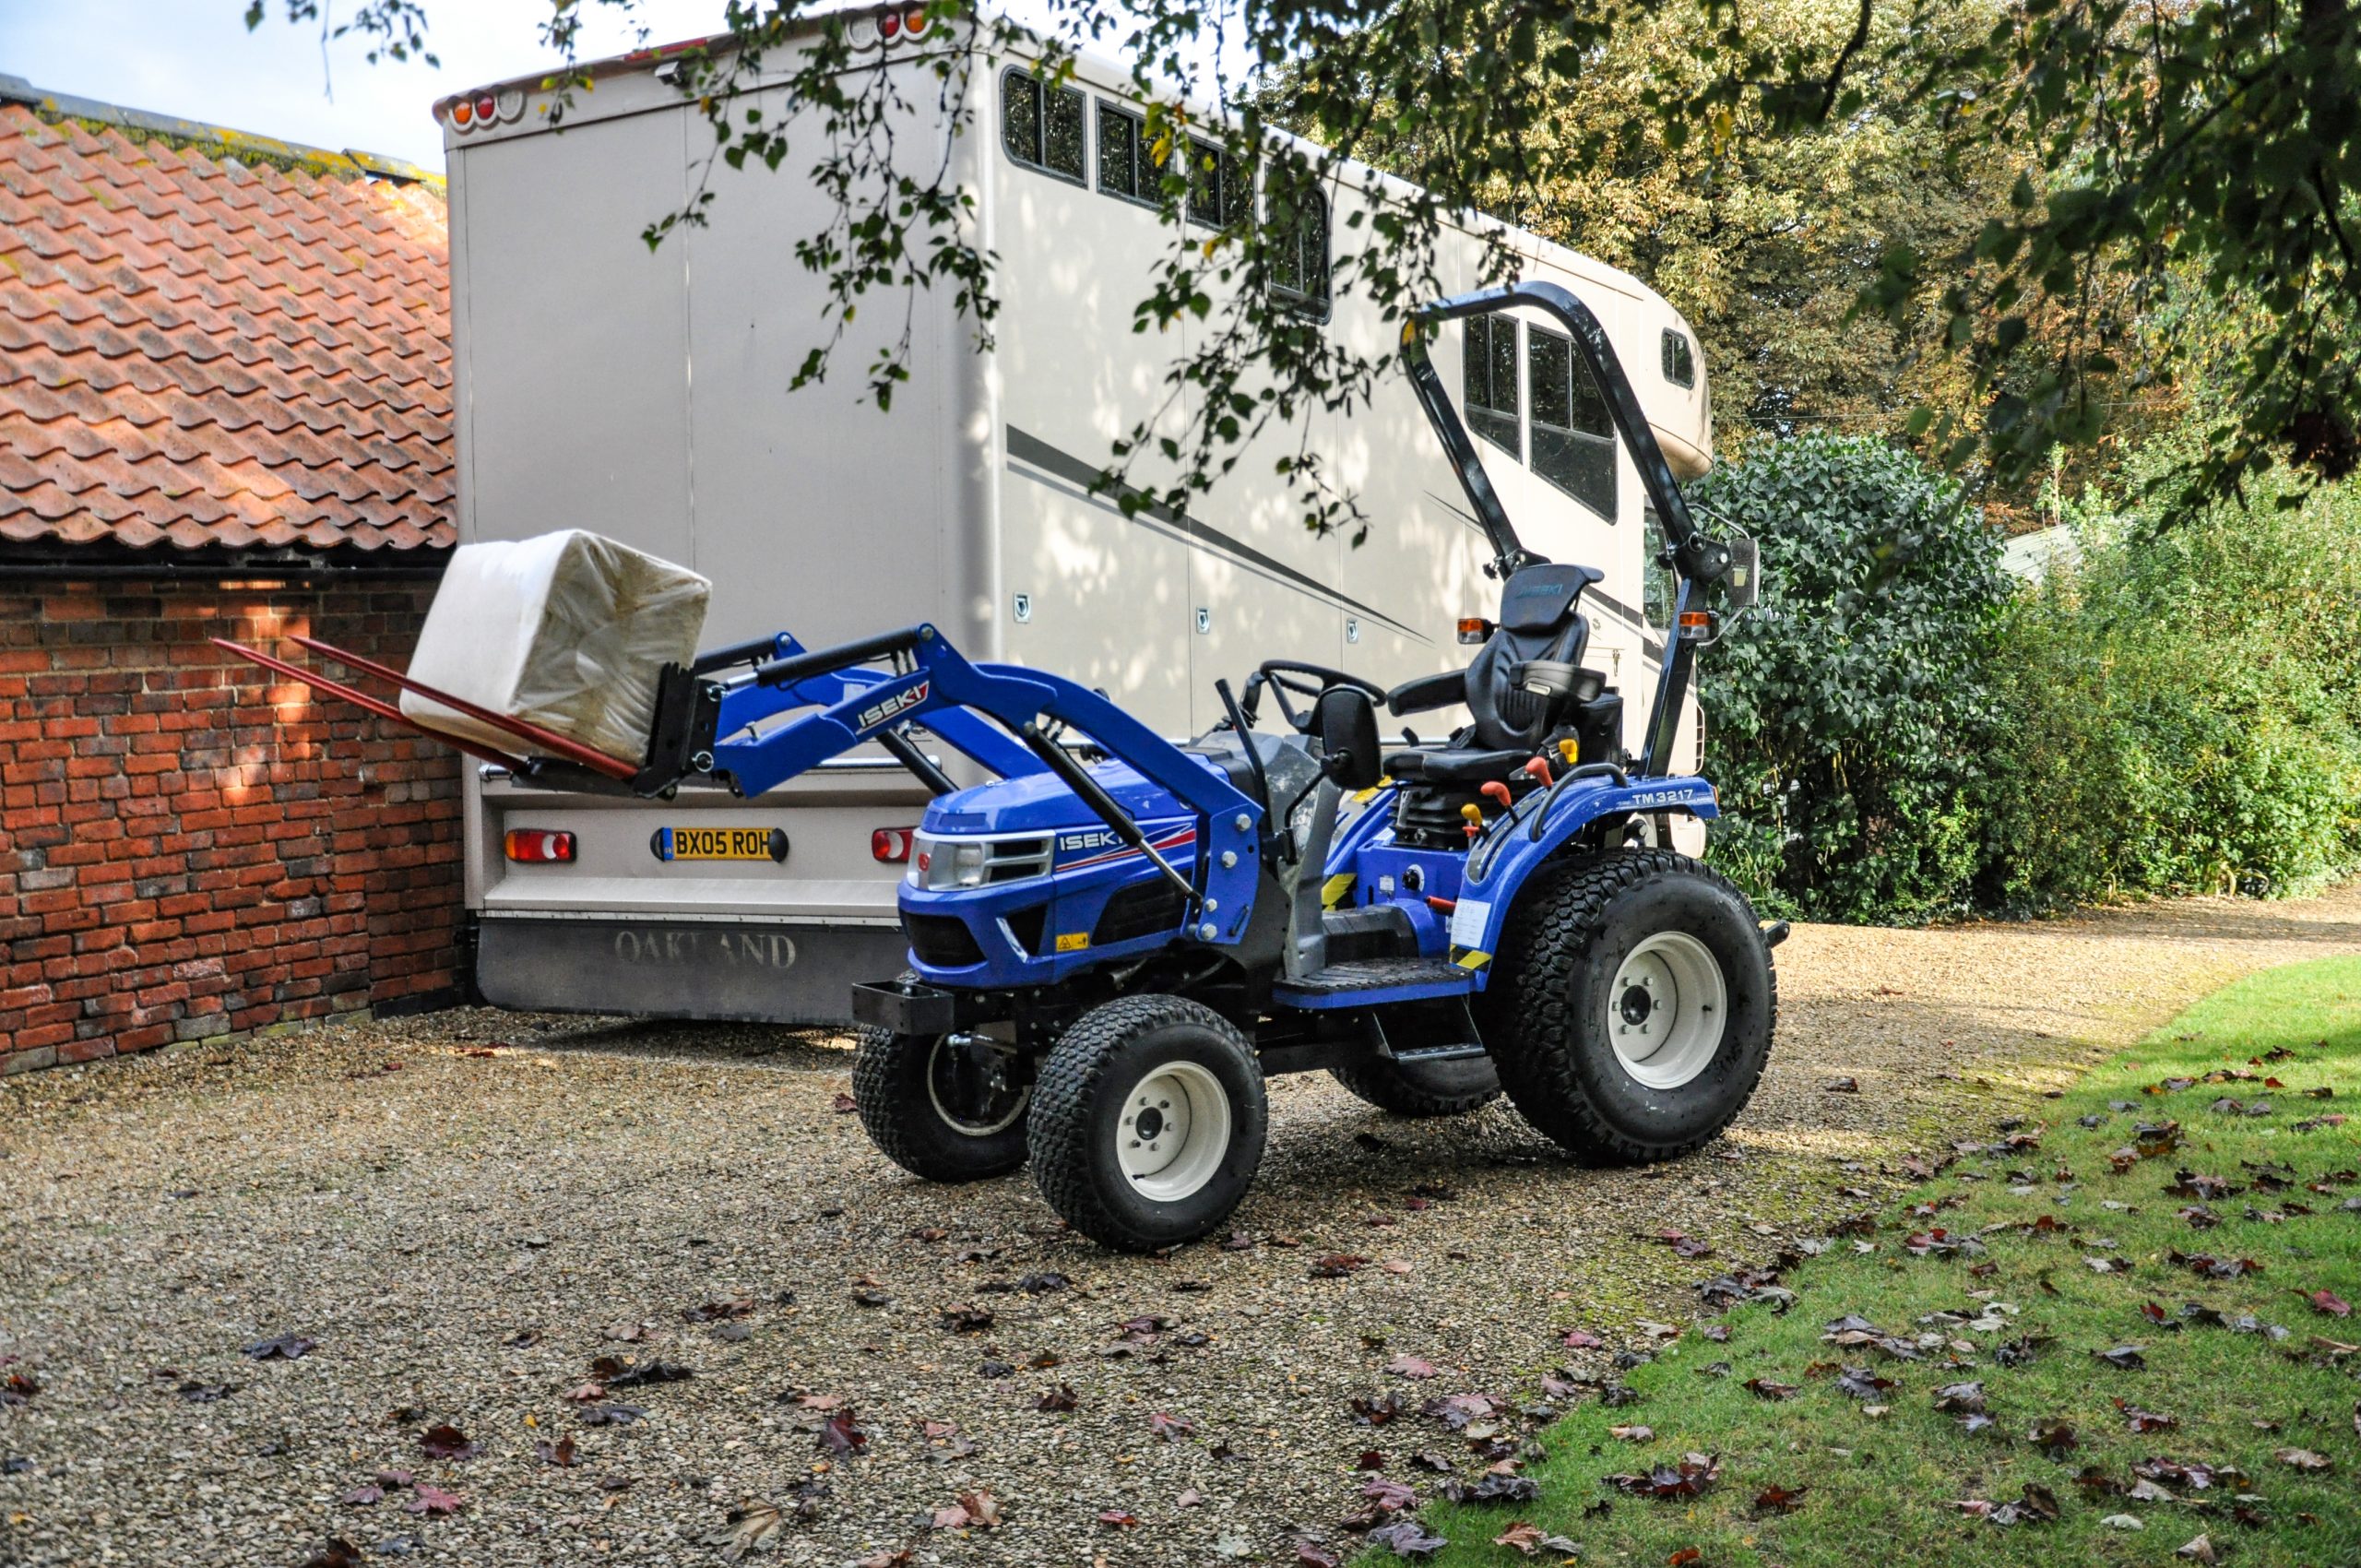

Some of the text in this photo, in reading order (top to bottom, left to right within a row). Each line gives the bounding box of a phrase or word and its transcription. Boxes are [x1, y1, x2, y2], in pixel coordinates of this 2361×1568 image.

[858, 685, 921, 728] ISEKI
[1631, 790, 1693, 805] TM 3217
[675, 831, 771, 855] BX05 ROH
